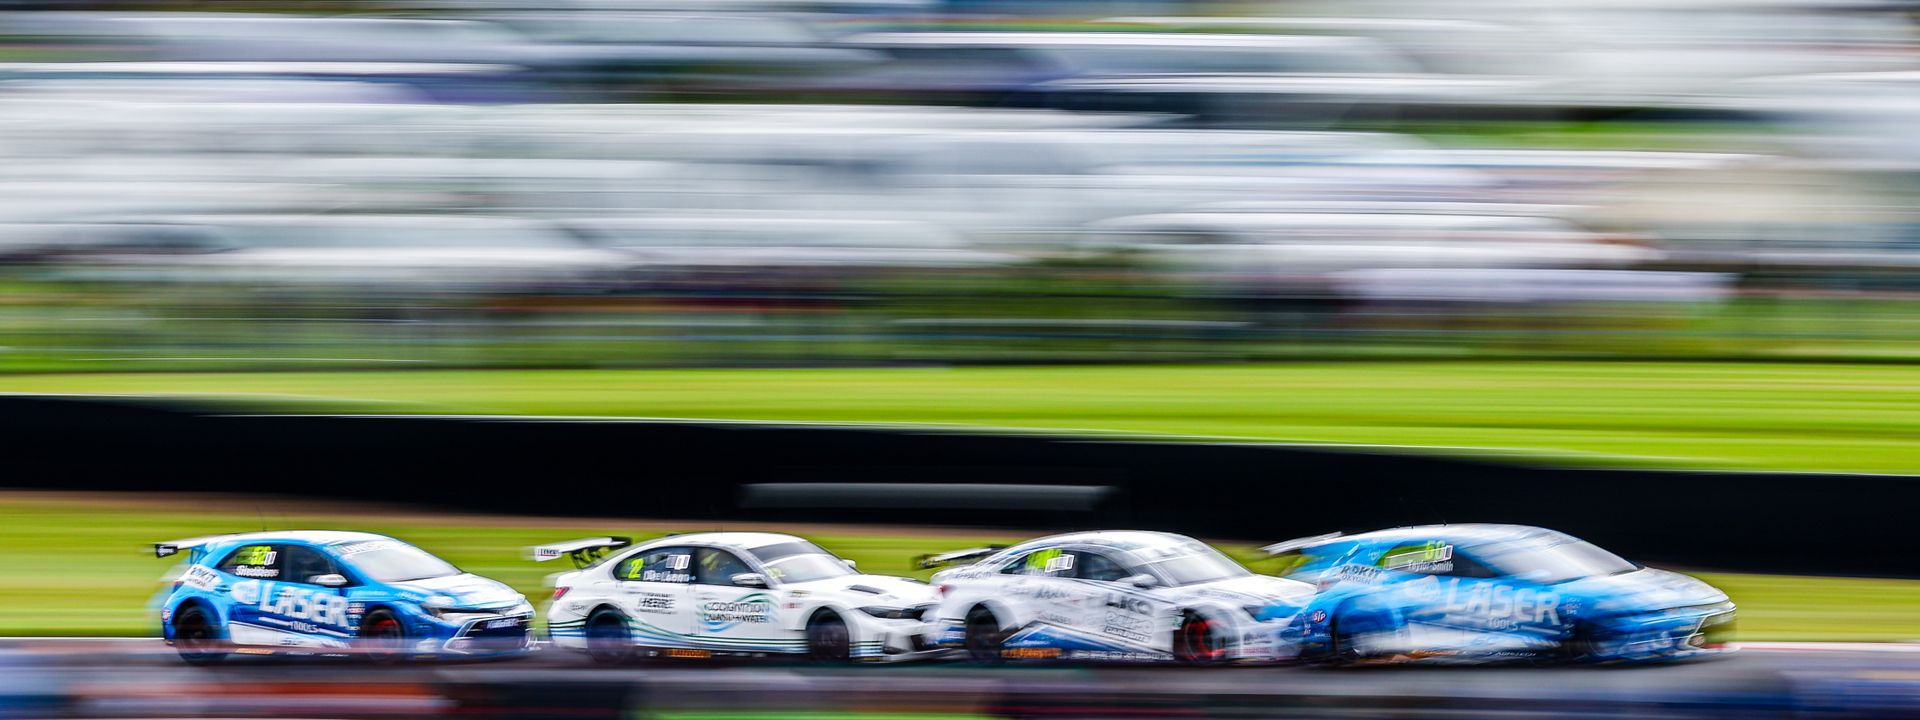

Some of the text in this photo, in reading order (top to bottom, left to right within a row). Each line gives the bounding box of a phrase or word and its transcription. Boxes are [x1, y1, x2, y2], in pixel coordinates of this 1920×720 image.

[259, 581, 349, 629] LASER
[1313, 610, 1326, 622] STP
[1444, 577, 1560, 625] LASER
